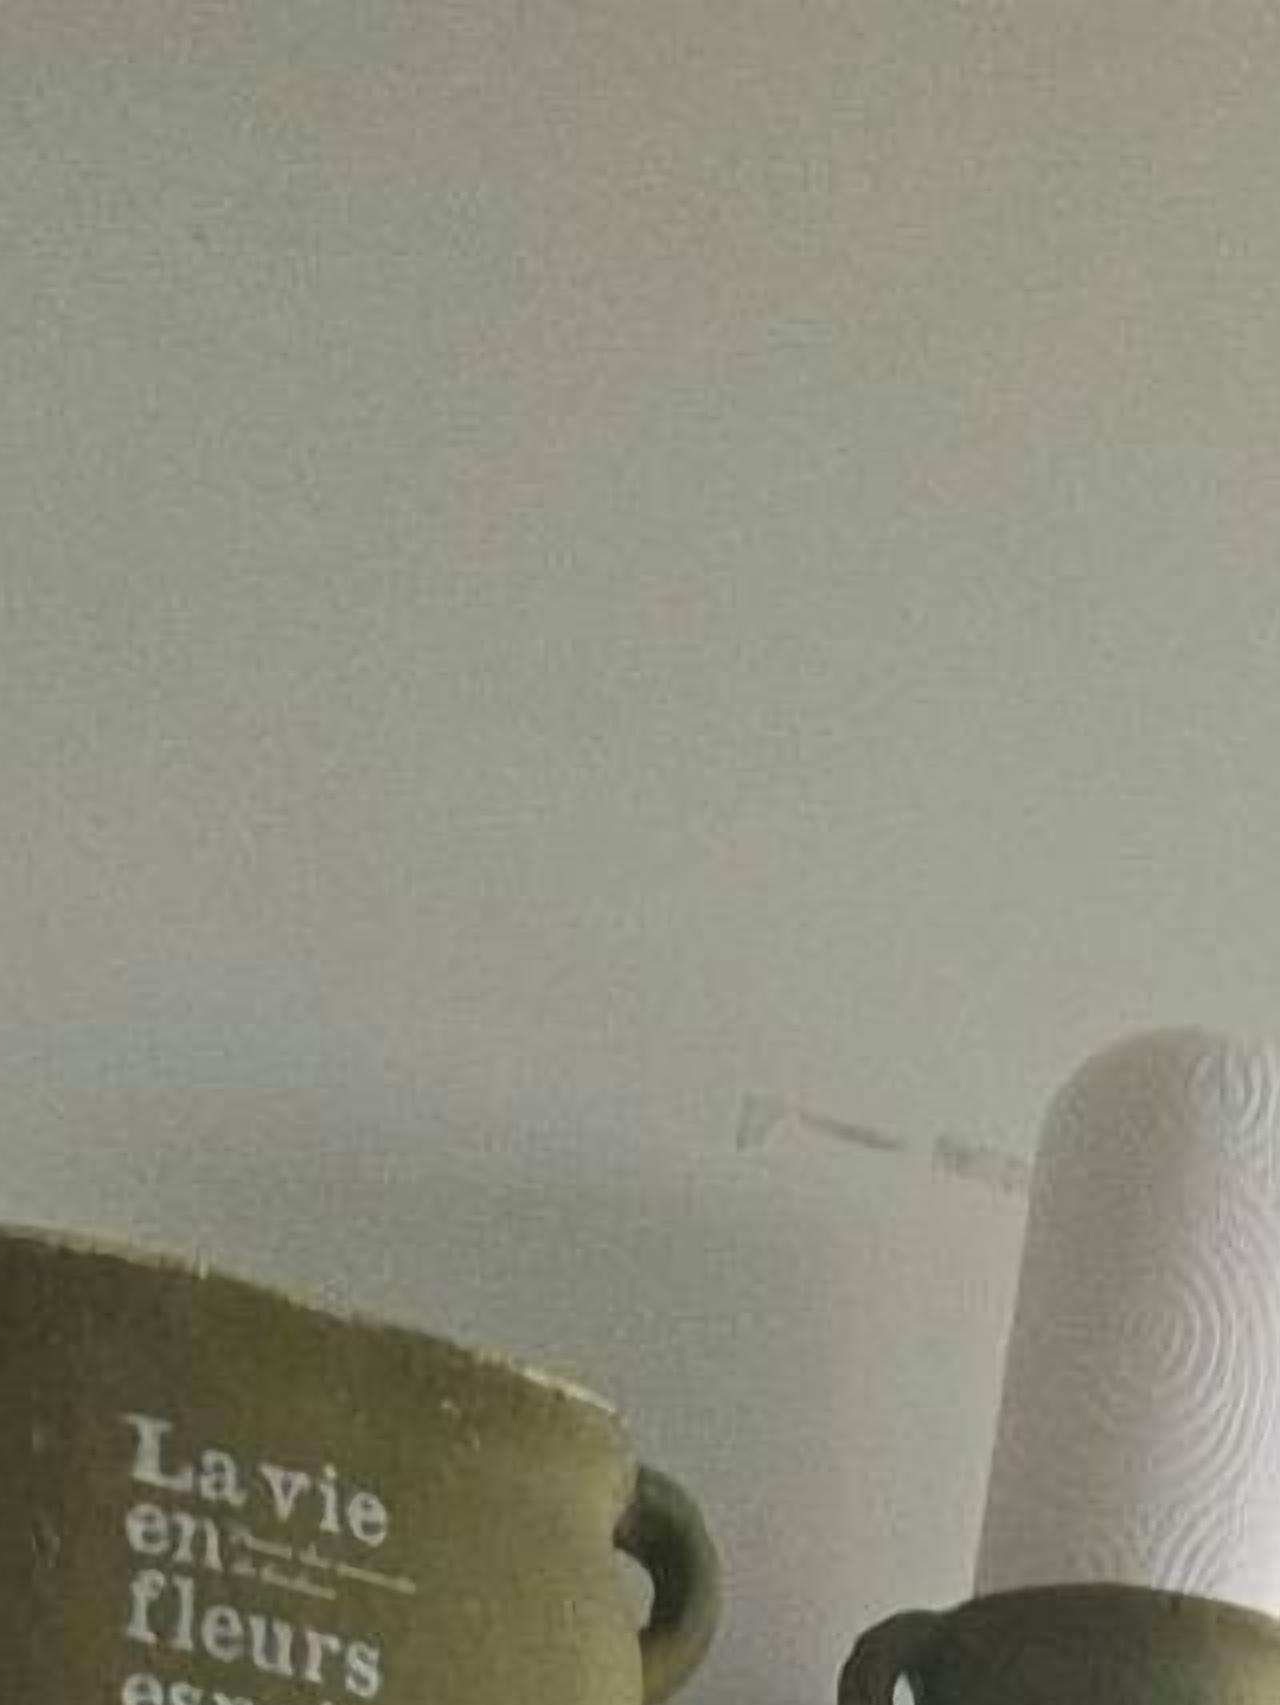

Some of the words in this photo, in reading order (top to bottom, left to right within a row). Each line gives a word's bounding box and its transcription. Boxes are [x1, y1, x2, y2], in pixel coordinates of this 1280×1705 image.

[122, 1411, 247, 1507] La
[258, 1461, 388, 1548] vie
[124, 1502, 223, 1573] en
[125, 1567, 383, 1699] fleurs
